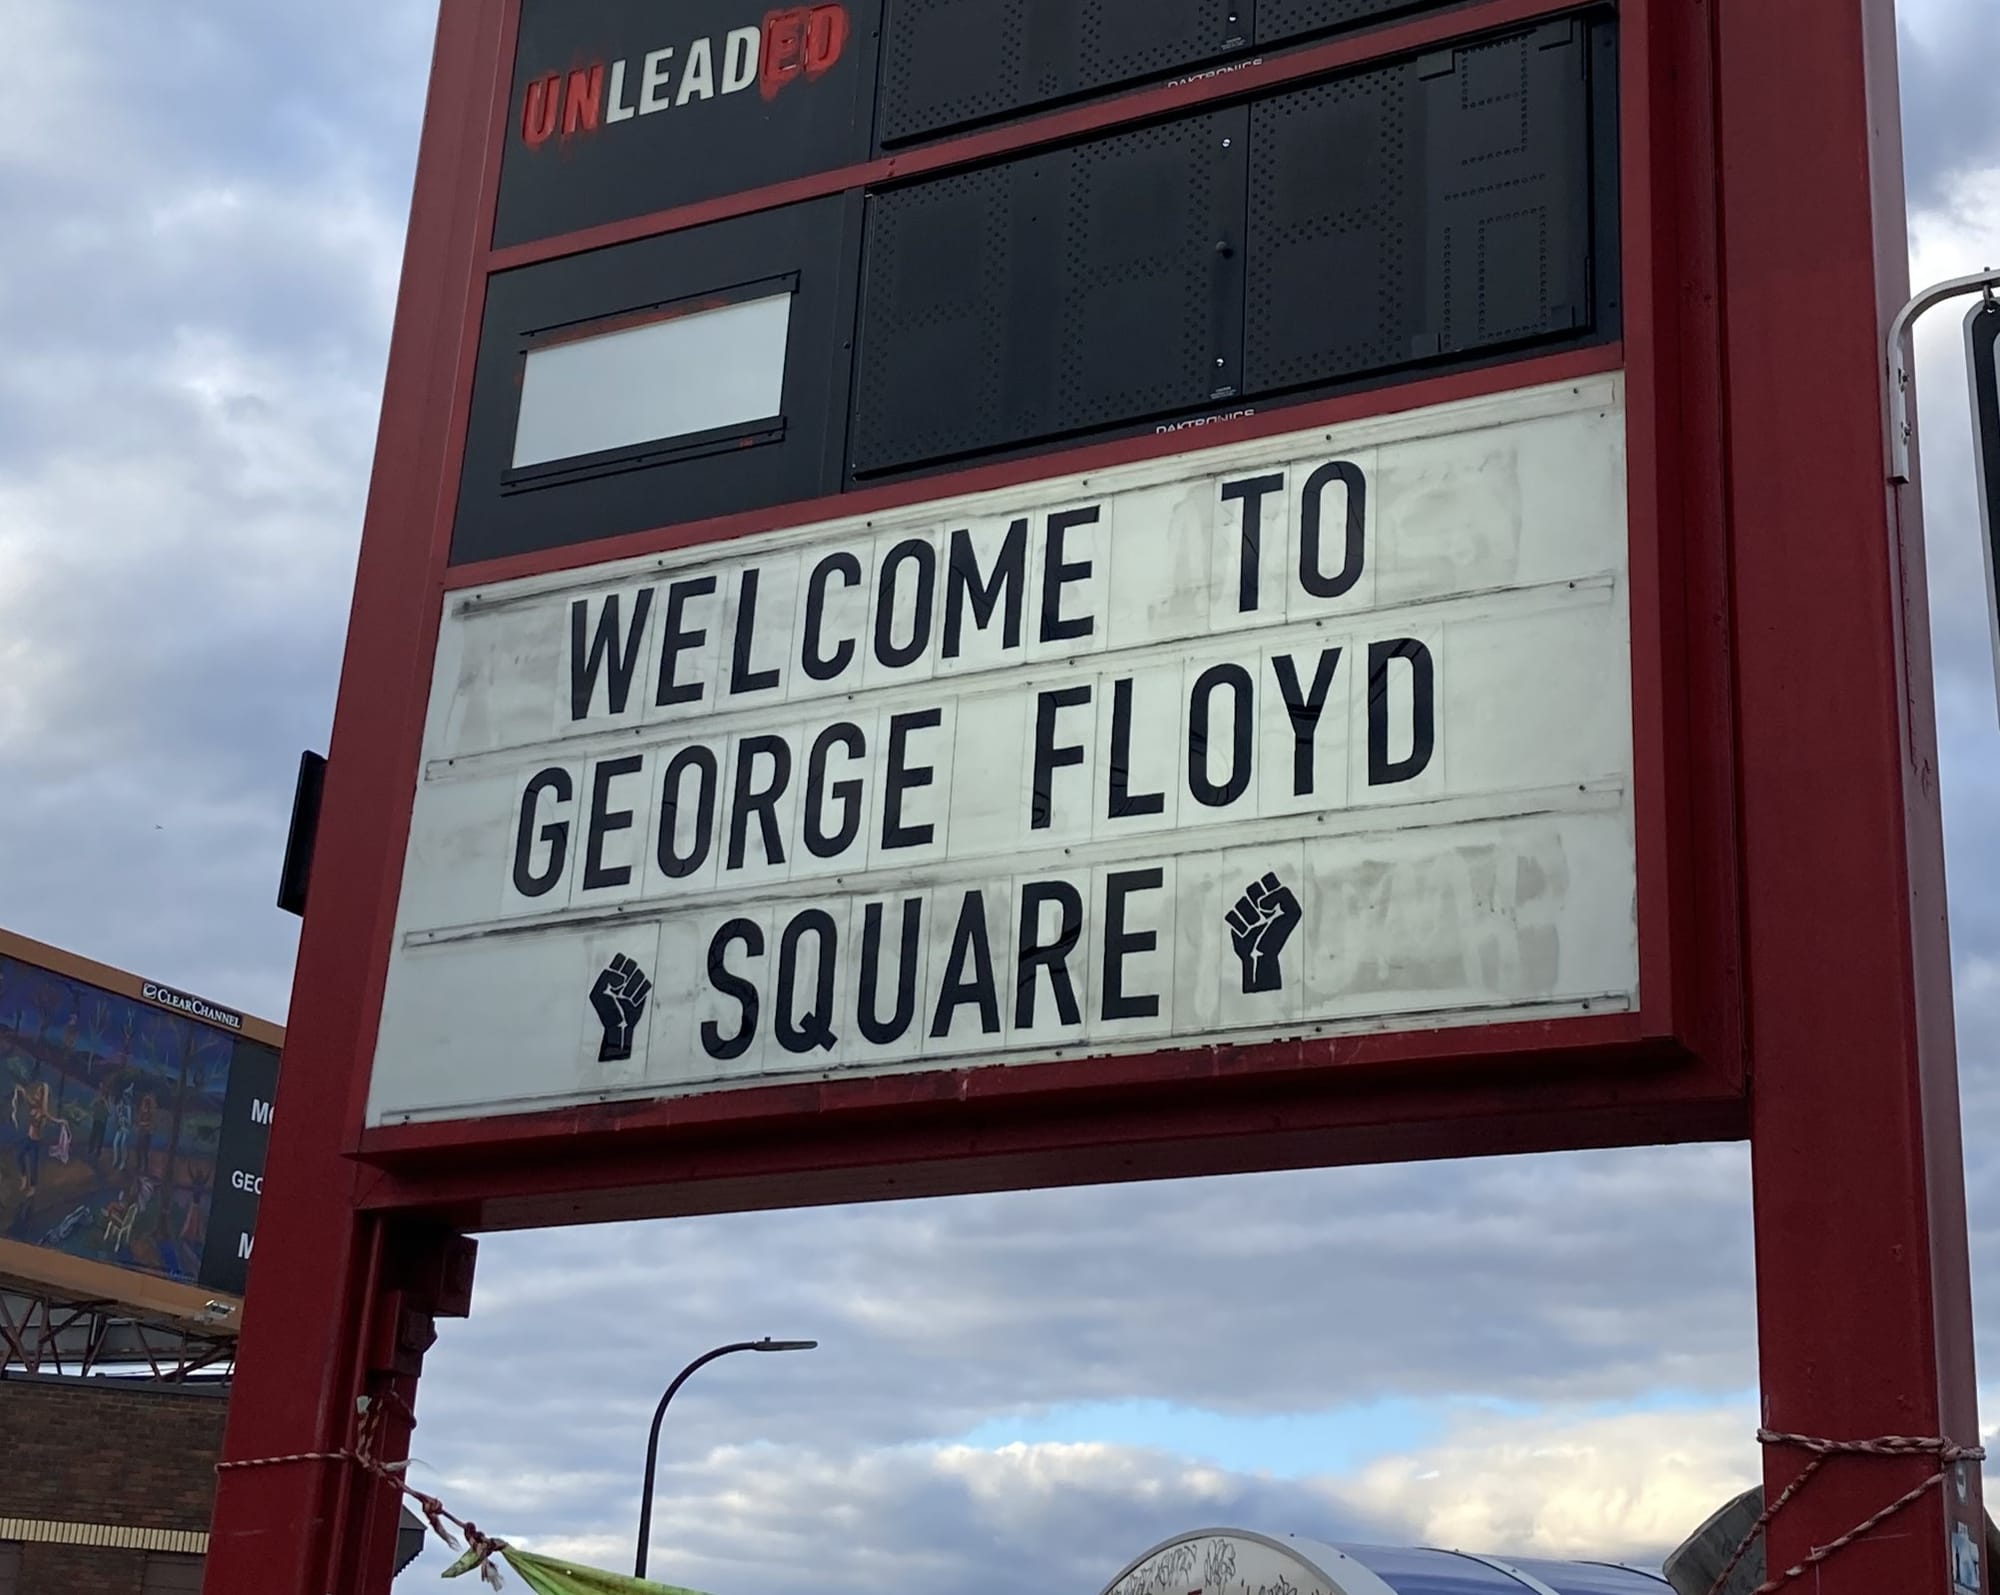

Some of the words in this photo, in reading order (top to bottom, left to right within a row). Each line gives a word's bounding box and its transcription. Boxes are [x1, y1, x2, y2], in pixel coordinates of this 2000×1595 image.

[570, 504, 1101, 721] WELCOME
[1221, 460, 1368, 612] TO
[512, 707, 942, 898] GEORGE
[1031, 637, 1434, 831] FLOYD
[701, 867, 1164, 1061] SQUARE
